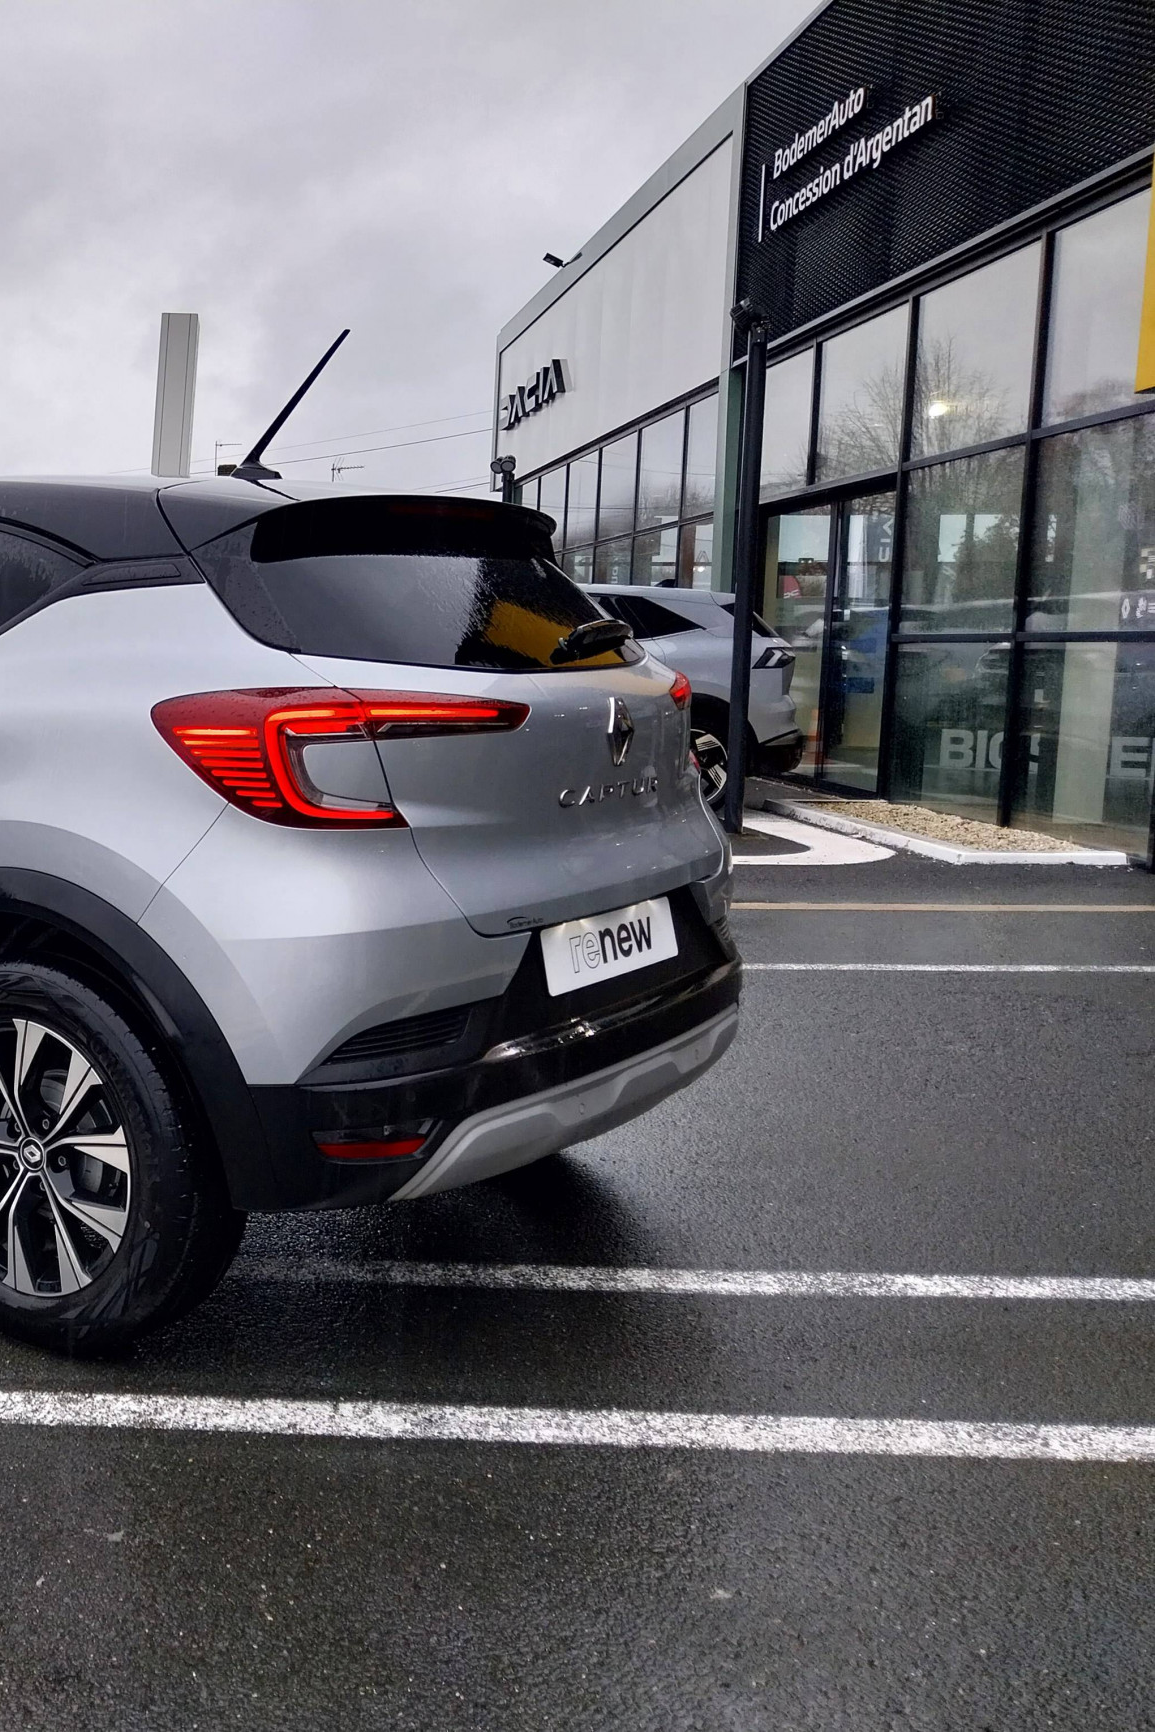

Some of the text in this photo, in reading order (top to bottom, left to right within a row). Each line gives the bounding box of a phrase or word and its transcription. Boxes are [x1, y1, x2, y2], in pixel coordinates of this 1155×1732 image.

[769, 95, 934, 231] Concession d'Argentan
[773, 86, 866, 180] BodemerAuto
[498, 358, 567, 430] DACIA
[558, 777, 658, 809] CAPTUR
[569, 916, 652, 973] renew
